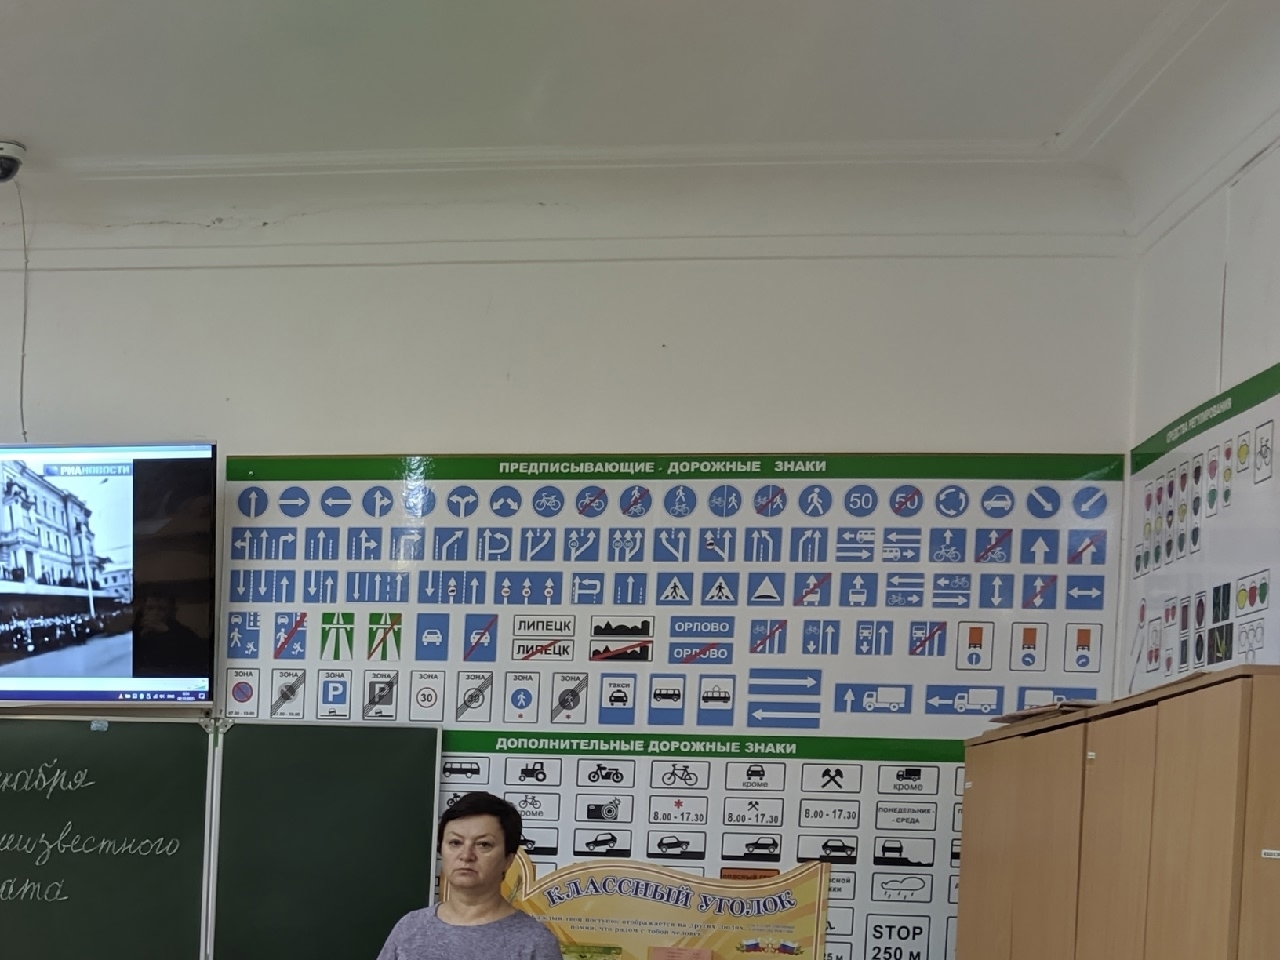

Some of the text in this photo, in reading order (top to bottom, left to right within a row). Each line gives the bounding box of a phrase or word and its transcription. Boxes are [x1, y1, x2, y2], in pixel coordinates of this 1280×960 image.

[499, 461, 826, 475] ПРЕДПИСЫВАЮЩИЕ ДОРОЖНЫЕ ЗНАКИ
[849, 493, 873, 509] 50
[895, 494, 919, 509] 50
[518, 620, 571, 632] ЛИПЕЦК
[674, 622, 730, 632] ОРЛОВО
[328, 683, 344, 702] P
[420, 693, 433, 702] 30
[495, 737, 797, 754] ДОПОЛНИТЕЛЬНЫЕ ДОРОЖНЫЕ ЗНАКИ
[742, 781, 768, 789] кроме
[680, 812, 705, 822] 17.30
[832, 809, 856, 820] 17.30
[544, 875, 797, 918] КЛАССНЫЙ УГОЛОК
[872, 924, 923, 941] STOP
